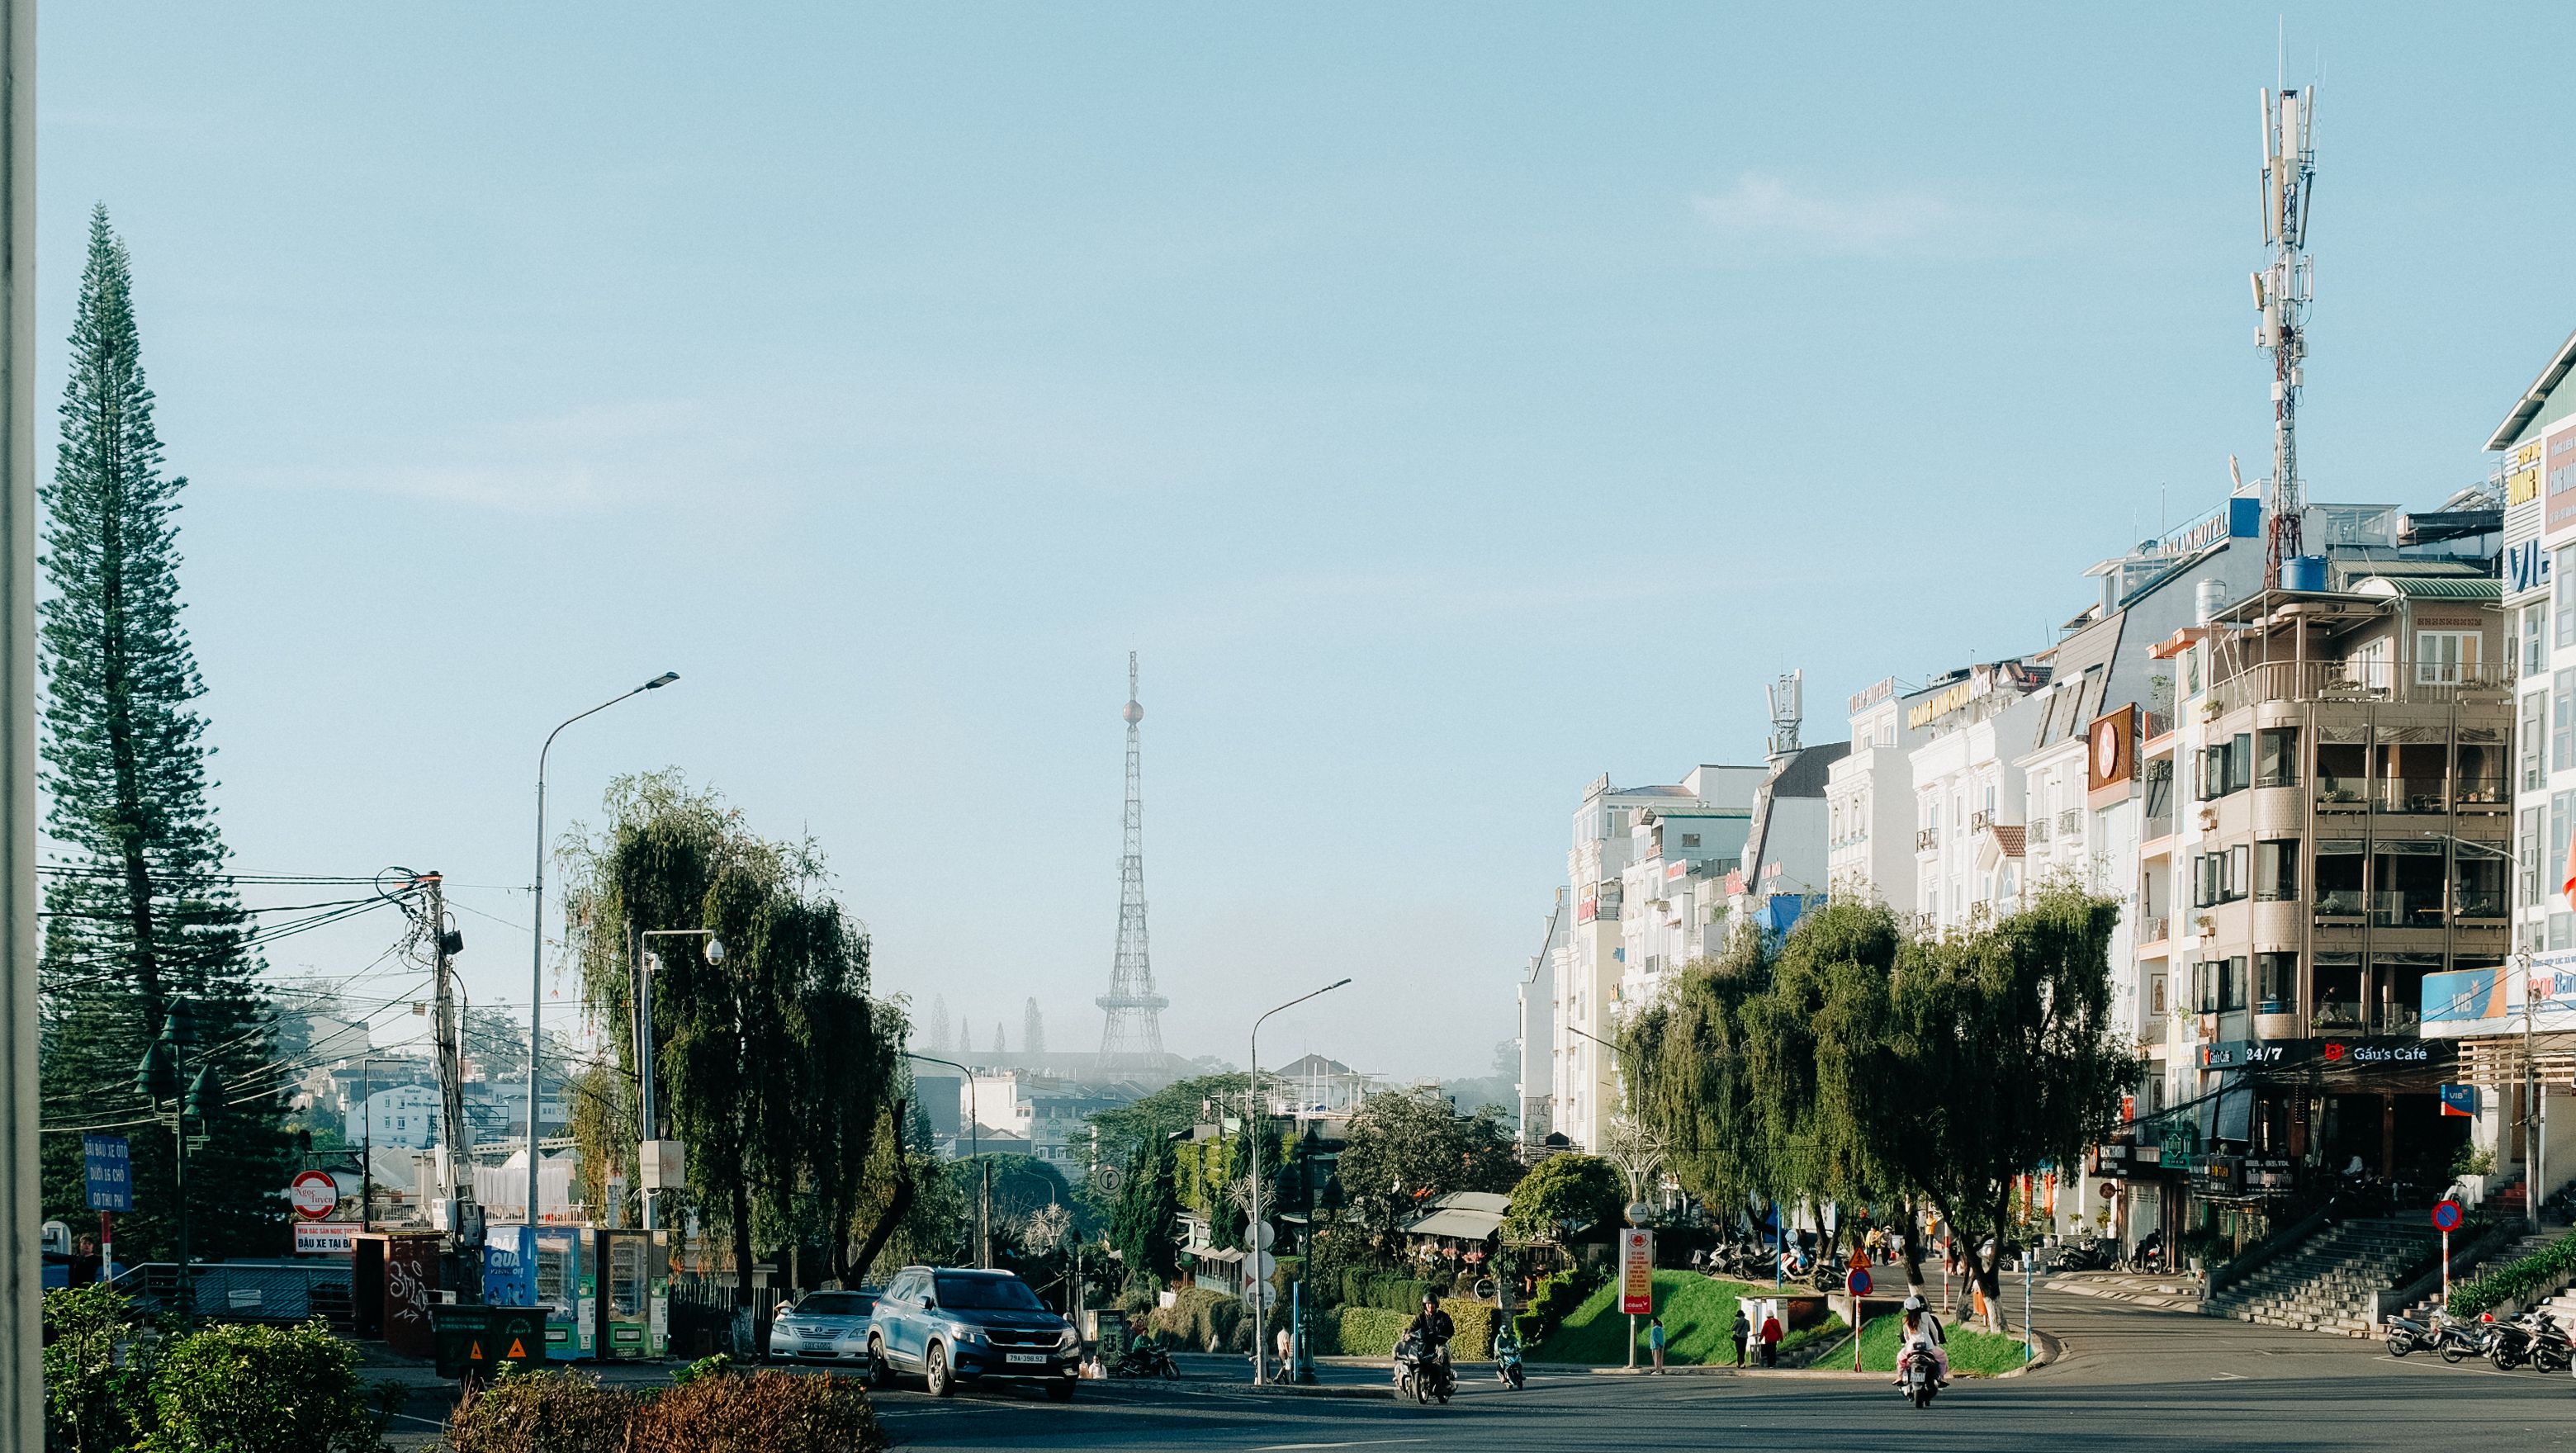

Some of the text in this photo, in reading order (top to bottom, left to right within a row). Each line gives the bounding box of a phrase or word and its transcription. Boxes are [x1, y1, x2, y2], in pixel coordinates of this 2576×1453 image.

[2194, 512, 2228, 547] HOTEL
[2452, 992, 2472, 1014] VIB
[2246, 1047, 2283, 1062] 24/7
[2394, 1047, 2427, 1060] Café
[107, 1144, 115, 1157] XE
[316, 1239, 326, 1247] XE
[329, 1239, 341, 1250] TẠI
